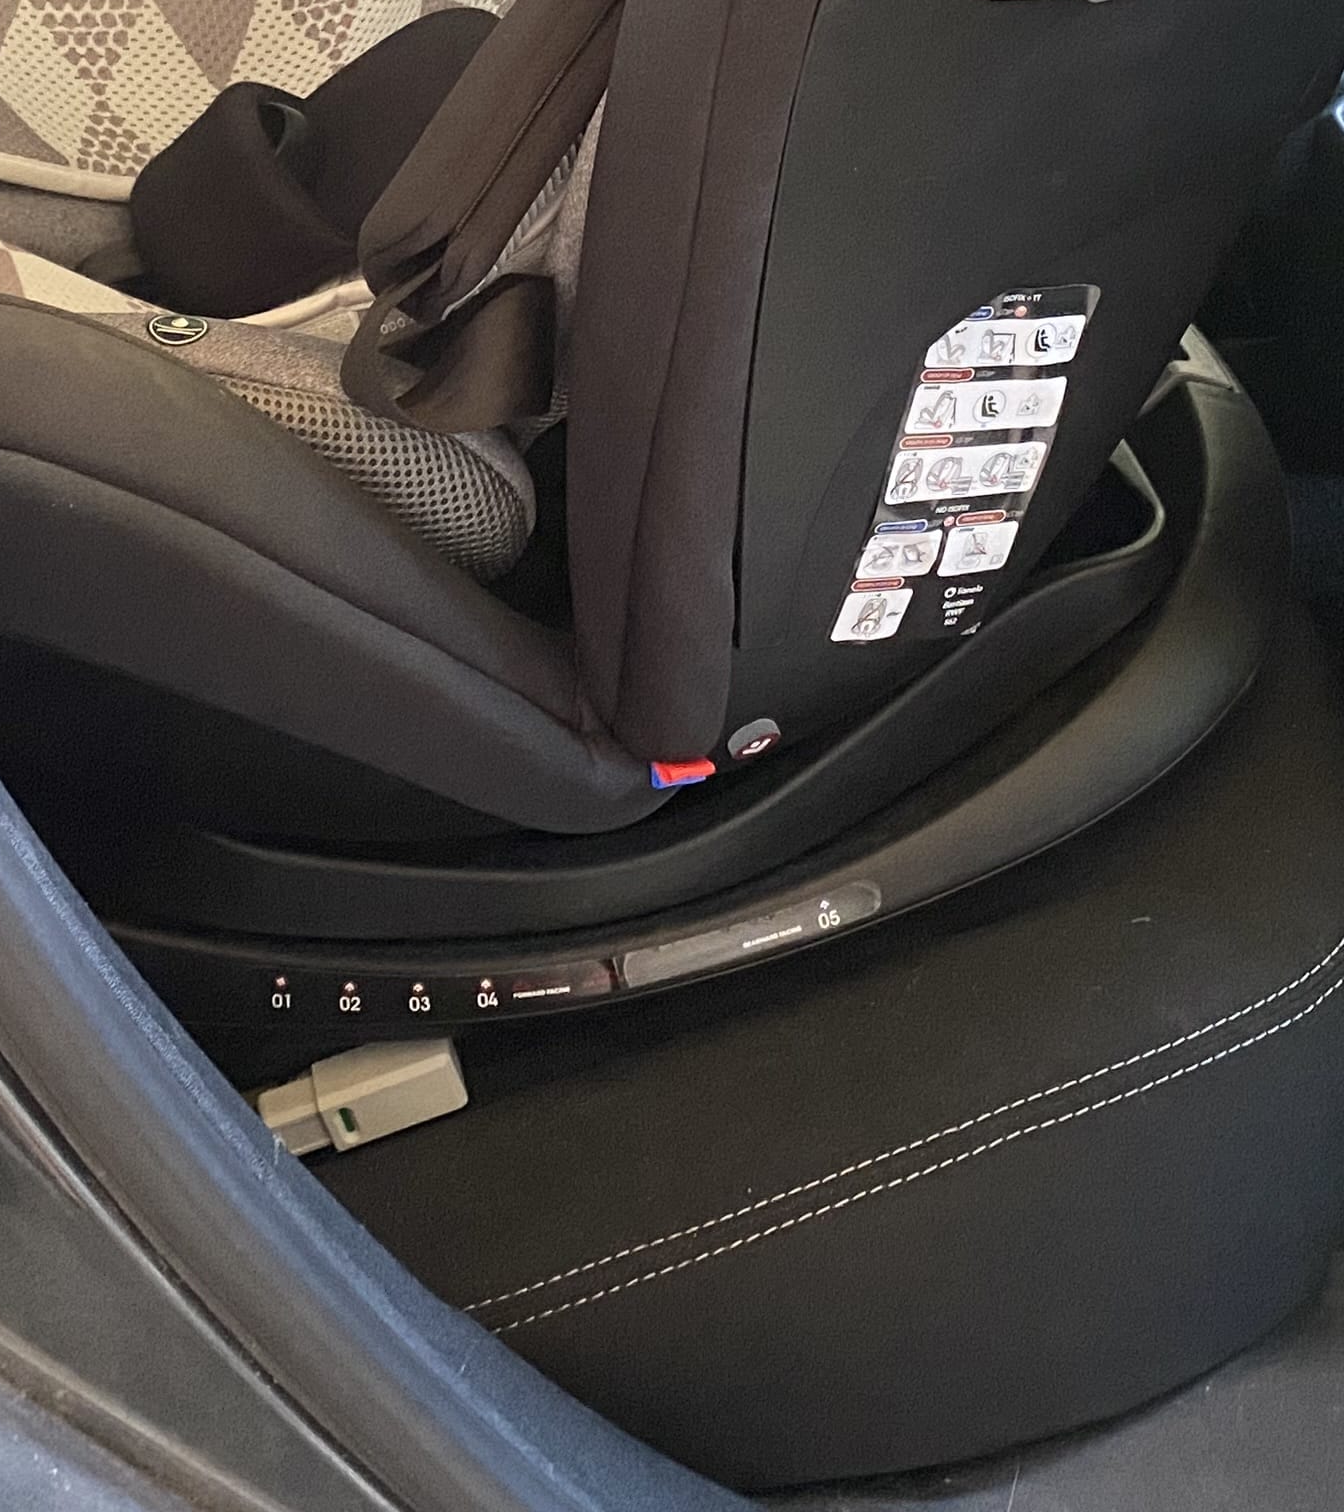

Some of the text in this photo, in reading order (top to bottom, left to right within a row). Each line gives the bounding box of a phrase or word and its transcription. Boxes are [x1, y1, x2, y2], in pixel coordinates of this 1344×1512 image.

[818, 909, 841, 929] 05
[271, 993, 292, 1009] 01
[339, 996, 361, 1012] 02
[408, 996, 431, 1012] 03
[477, 991, 499, 1008] 04
